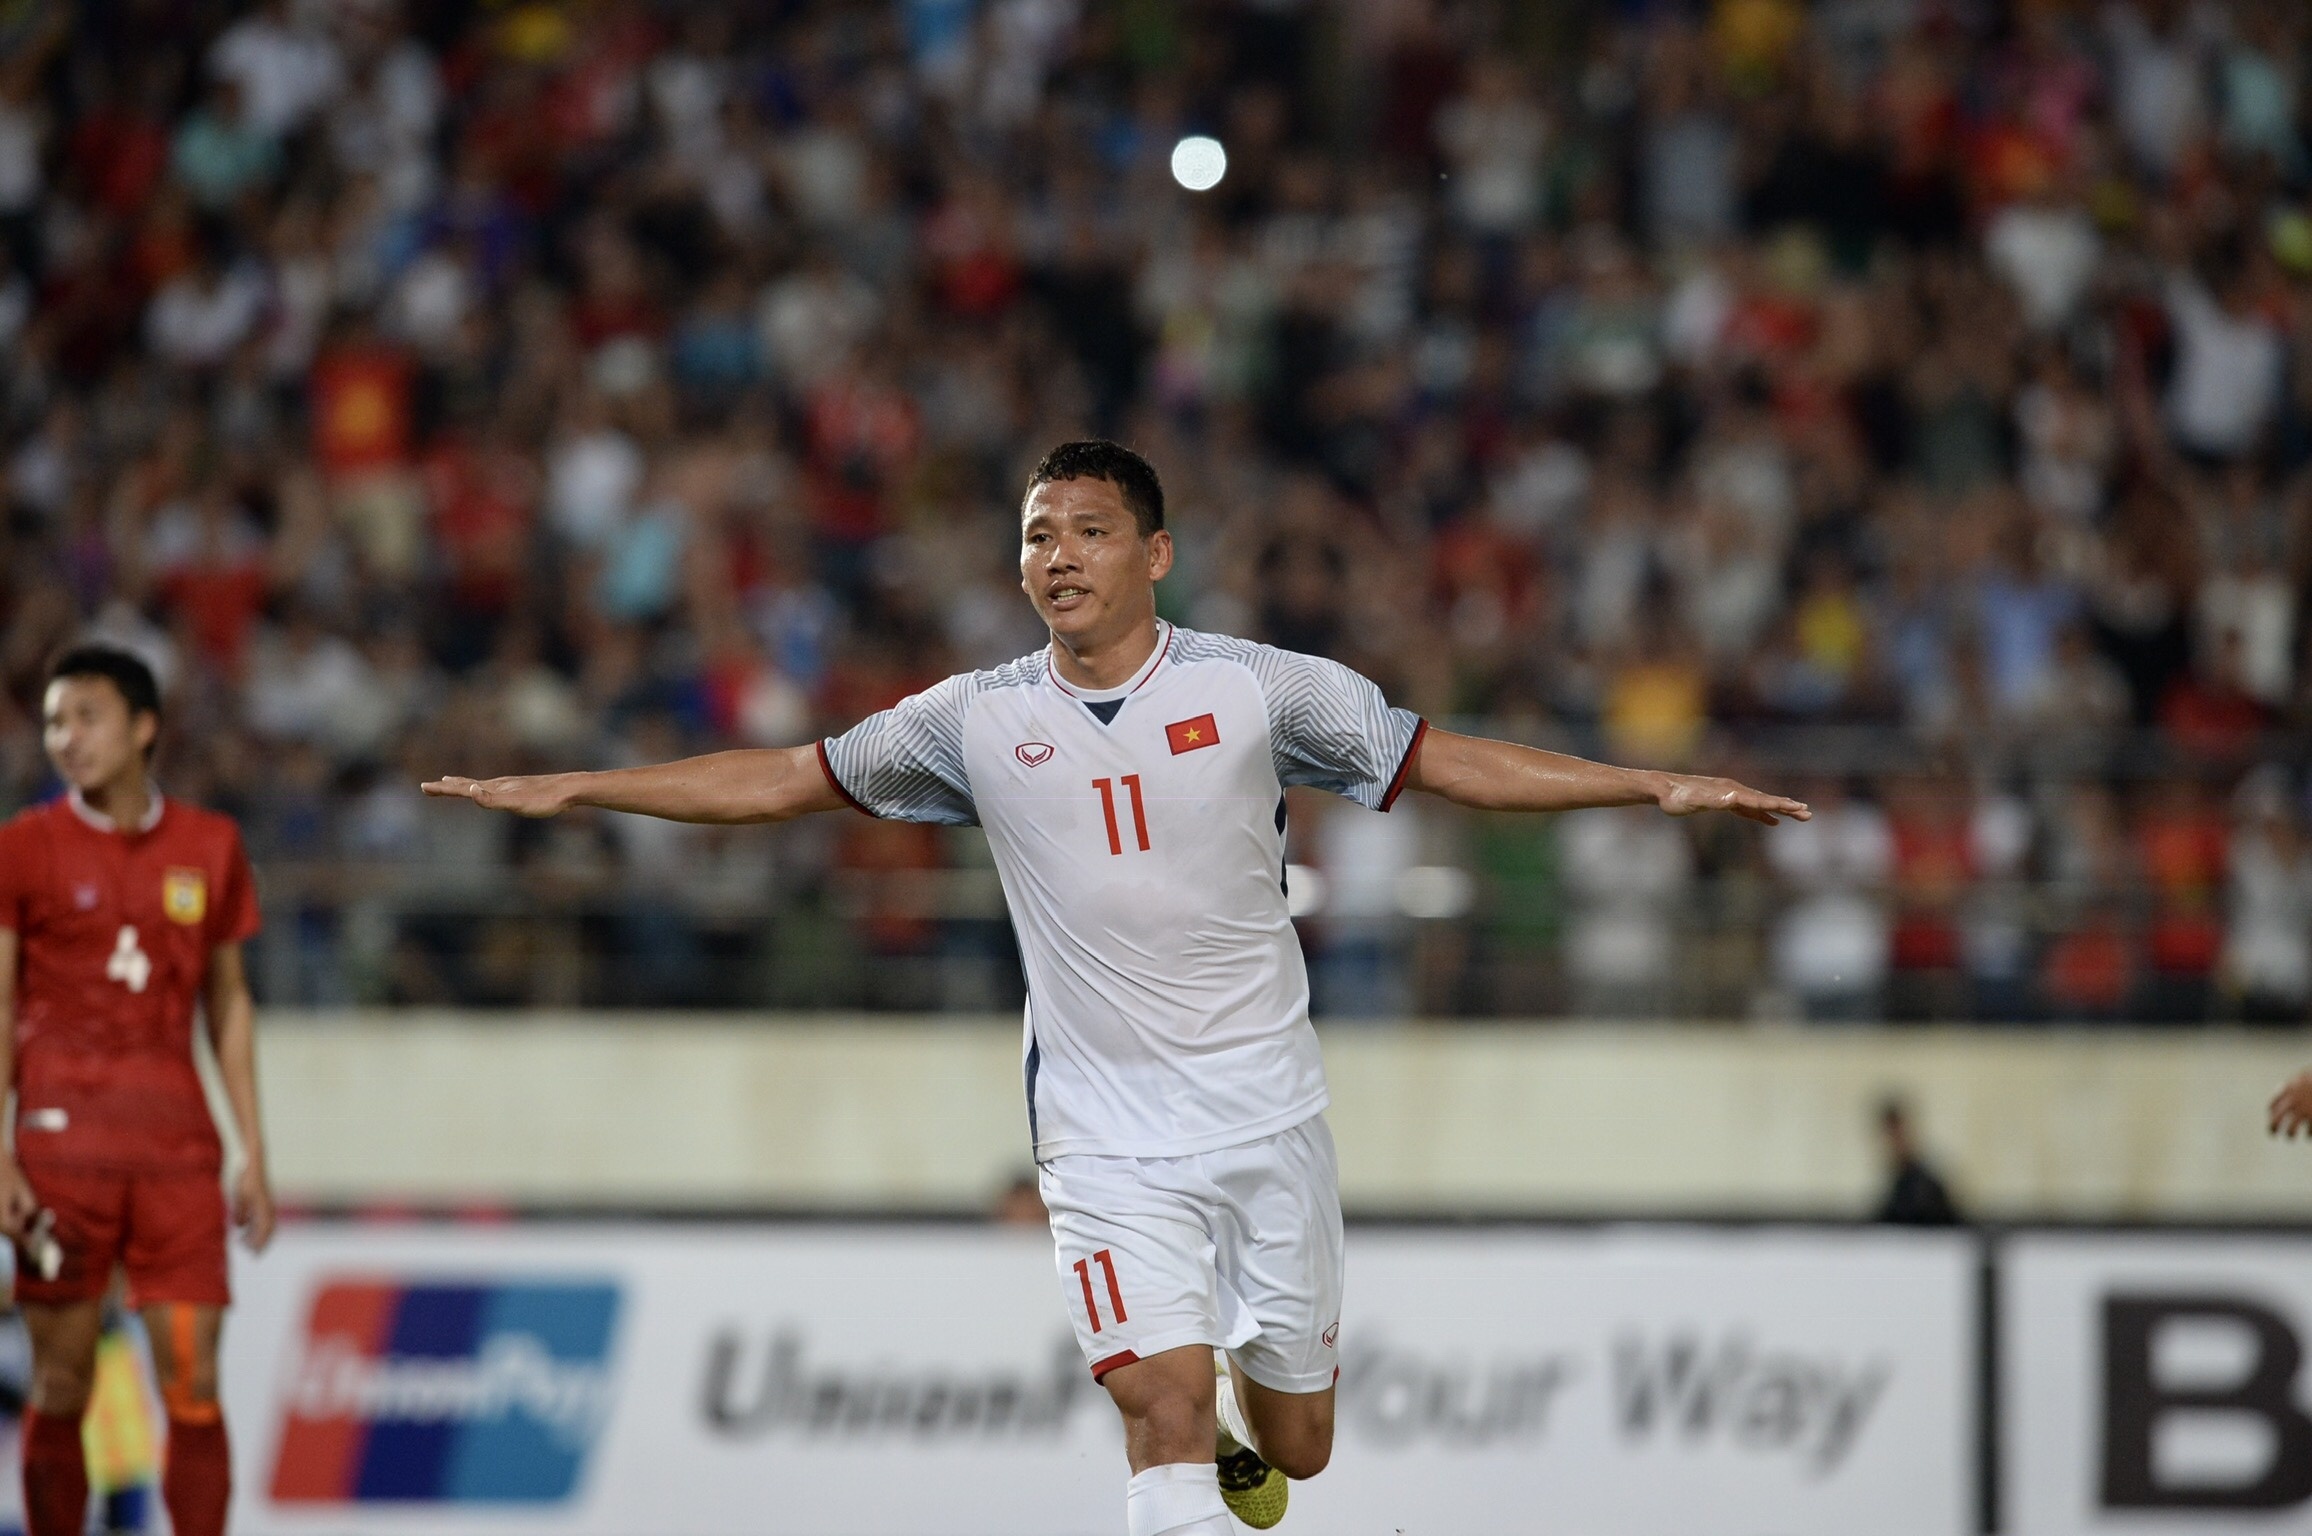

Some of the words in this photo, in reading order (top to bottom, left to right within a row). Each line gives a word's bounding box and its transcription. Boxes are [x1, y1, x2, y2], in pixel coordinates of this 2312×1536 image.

[1092, 774, 1150, 856] 11
[107, 924, 152, 994] 4
[1073, 1249, 1127, 1334] 11
[1612, 1334, 1888, 1478] Way
[2096, 1292, 2312, 1511] B
